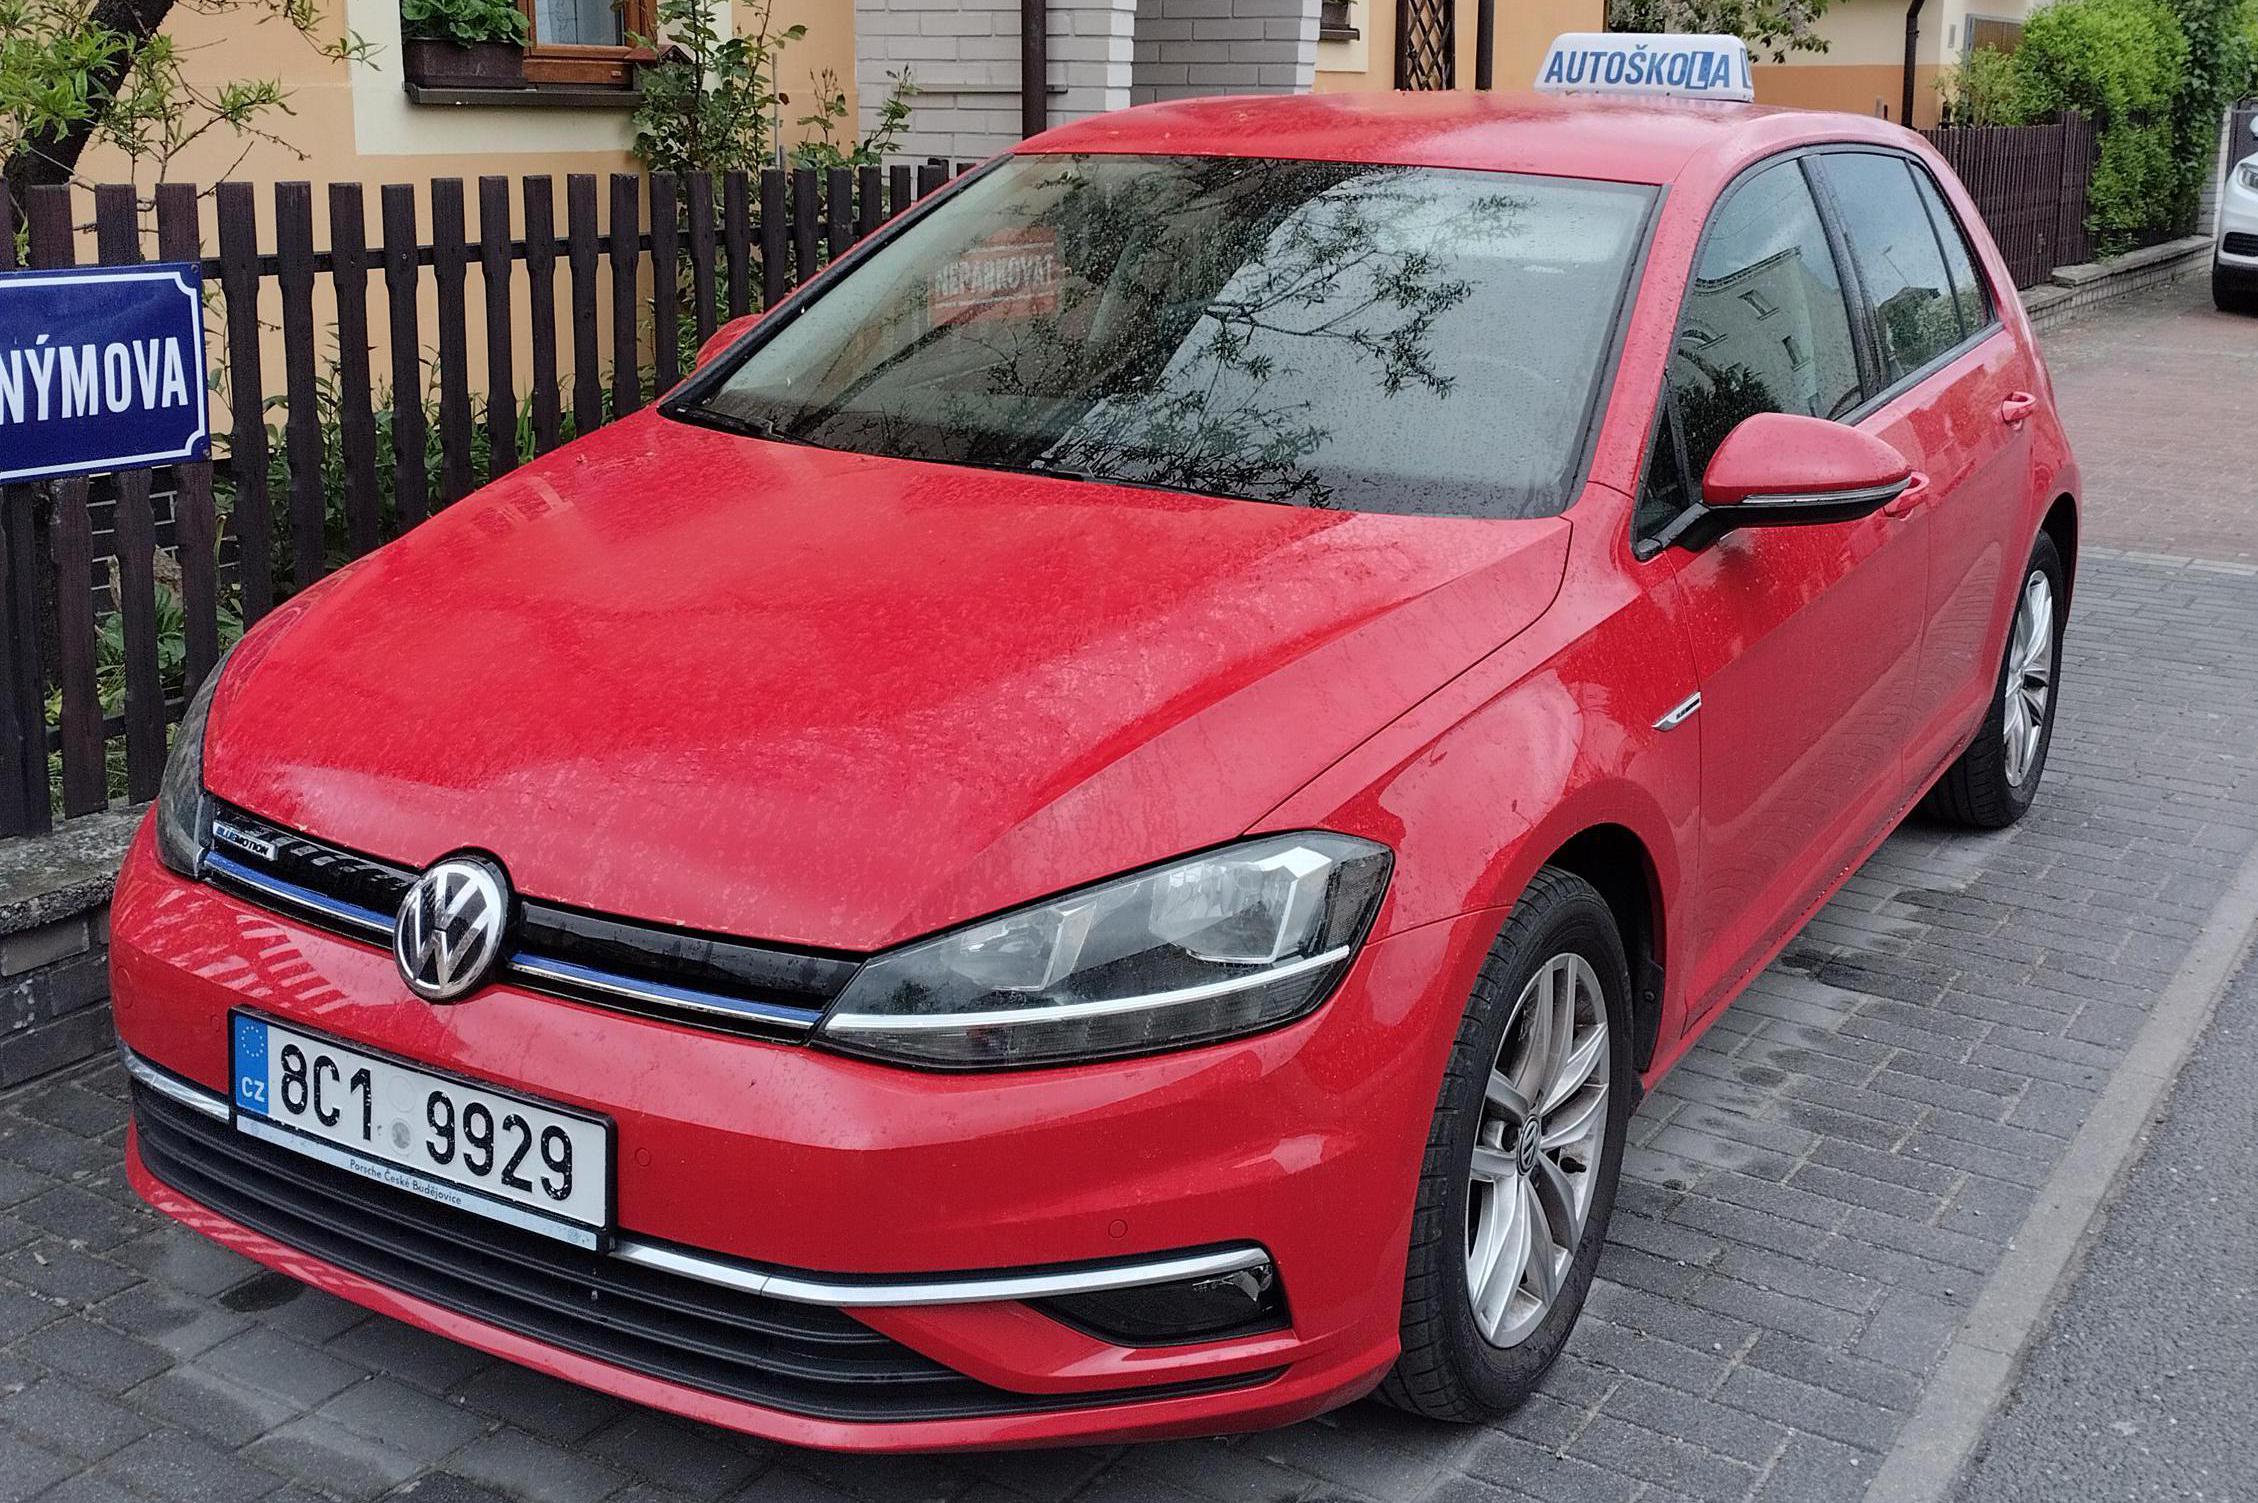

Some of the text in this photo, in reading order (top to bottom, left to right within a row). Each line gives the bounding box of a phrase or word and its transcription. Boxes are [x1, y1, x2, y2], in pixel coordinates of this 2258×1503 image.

[1544, 44, 1730, 90] AUTOŠKOLA
[241, 1076, 265, 1103] CZ
[281, 1044, 573, 1201] 8C1 9929
[350, 1159, 462, 1205] Porsche České Budějovice
